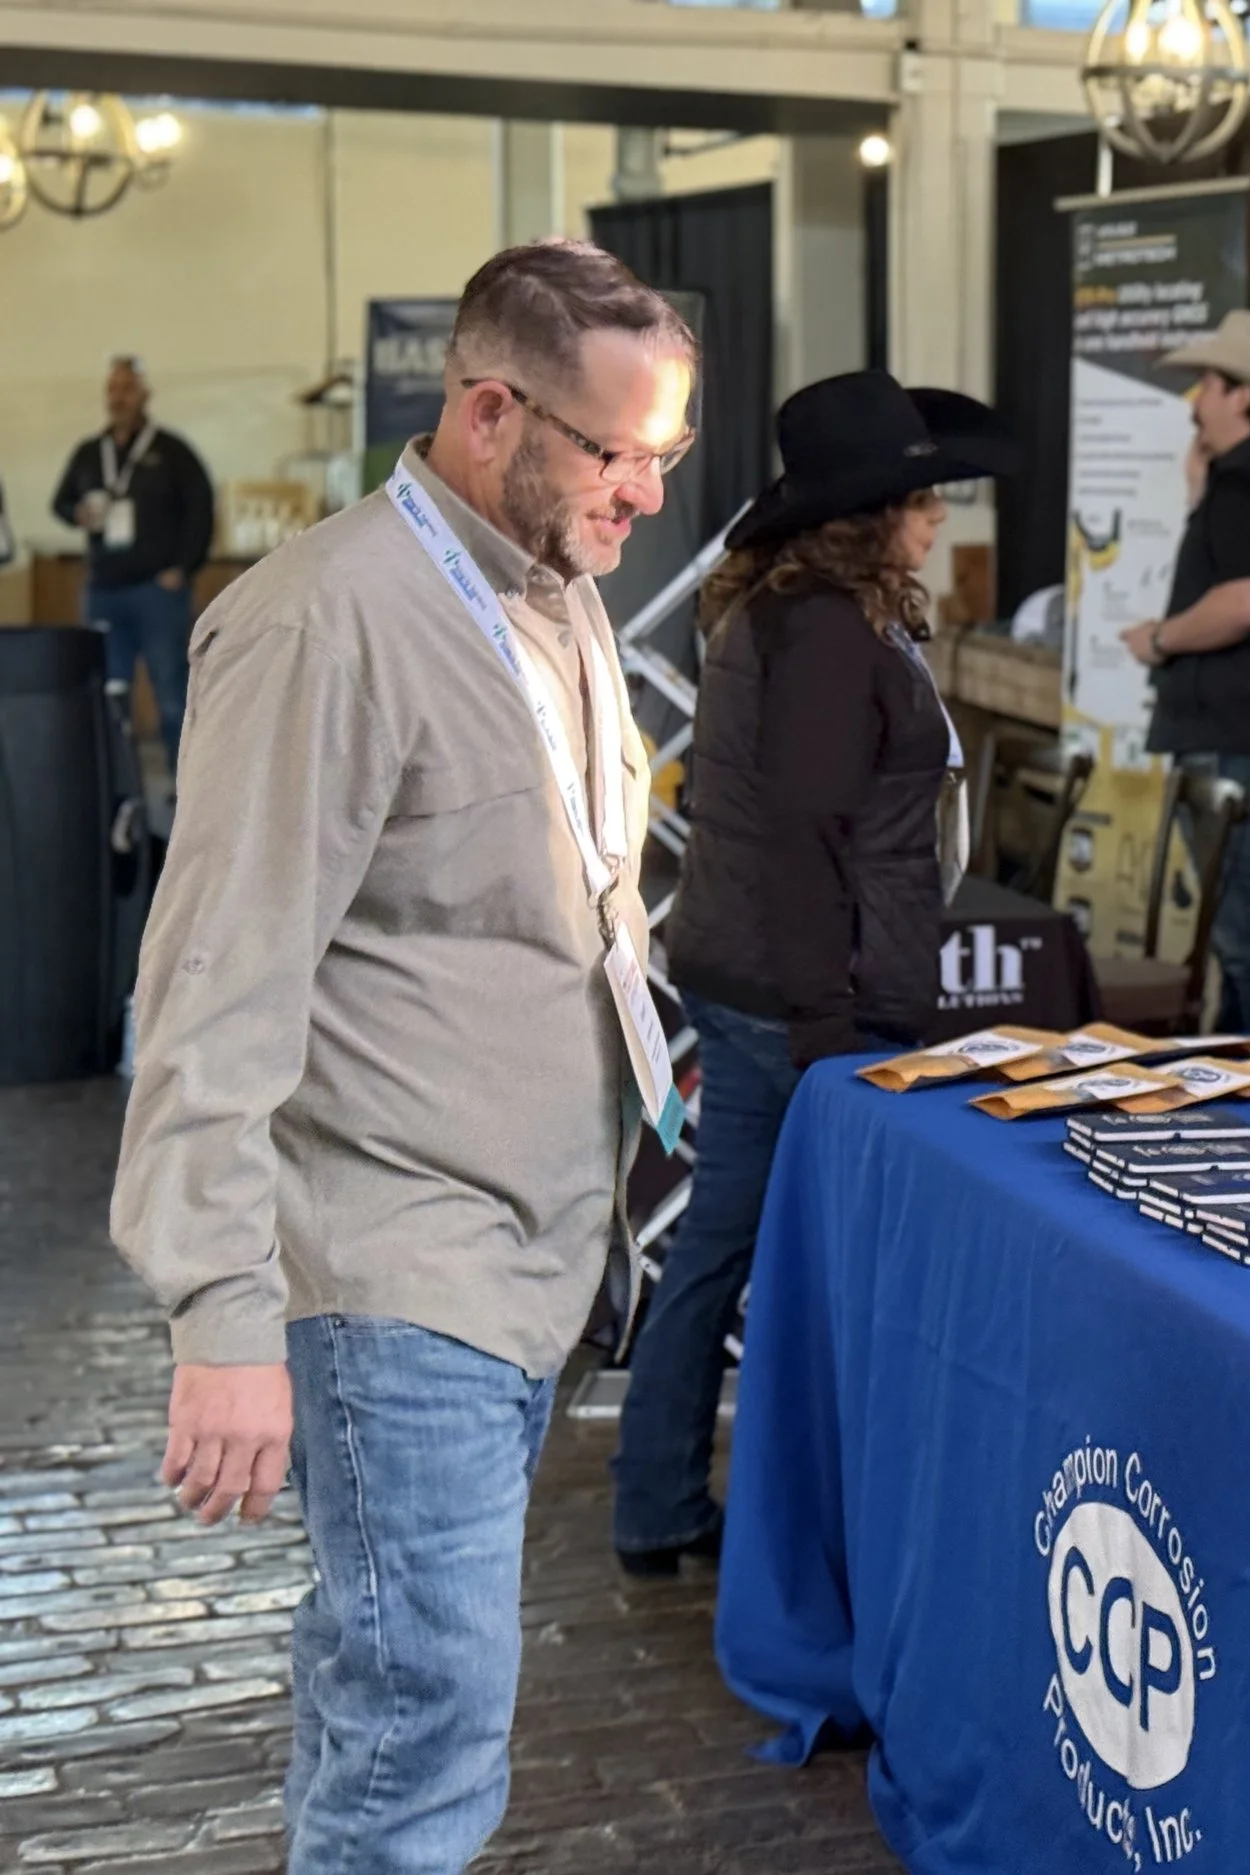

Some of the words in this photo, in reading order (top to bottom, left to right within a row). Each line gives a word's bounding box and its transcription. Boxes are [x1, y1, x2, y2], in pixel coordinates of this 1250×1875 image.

[1034, 1434, 1118, 1556] Champion
[1125, 1452, 1216, 1680] Corrosion
[1061, 1546, 1182, 1732] CCP
[1145, 1806, 1202, 1863] Inc.
